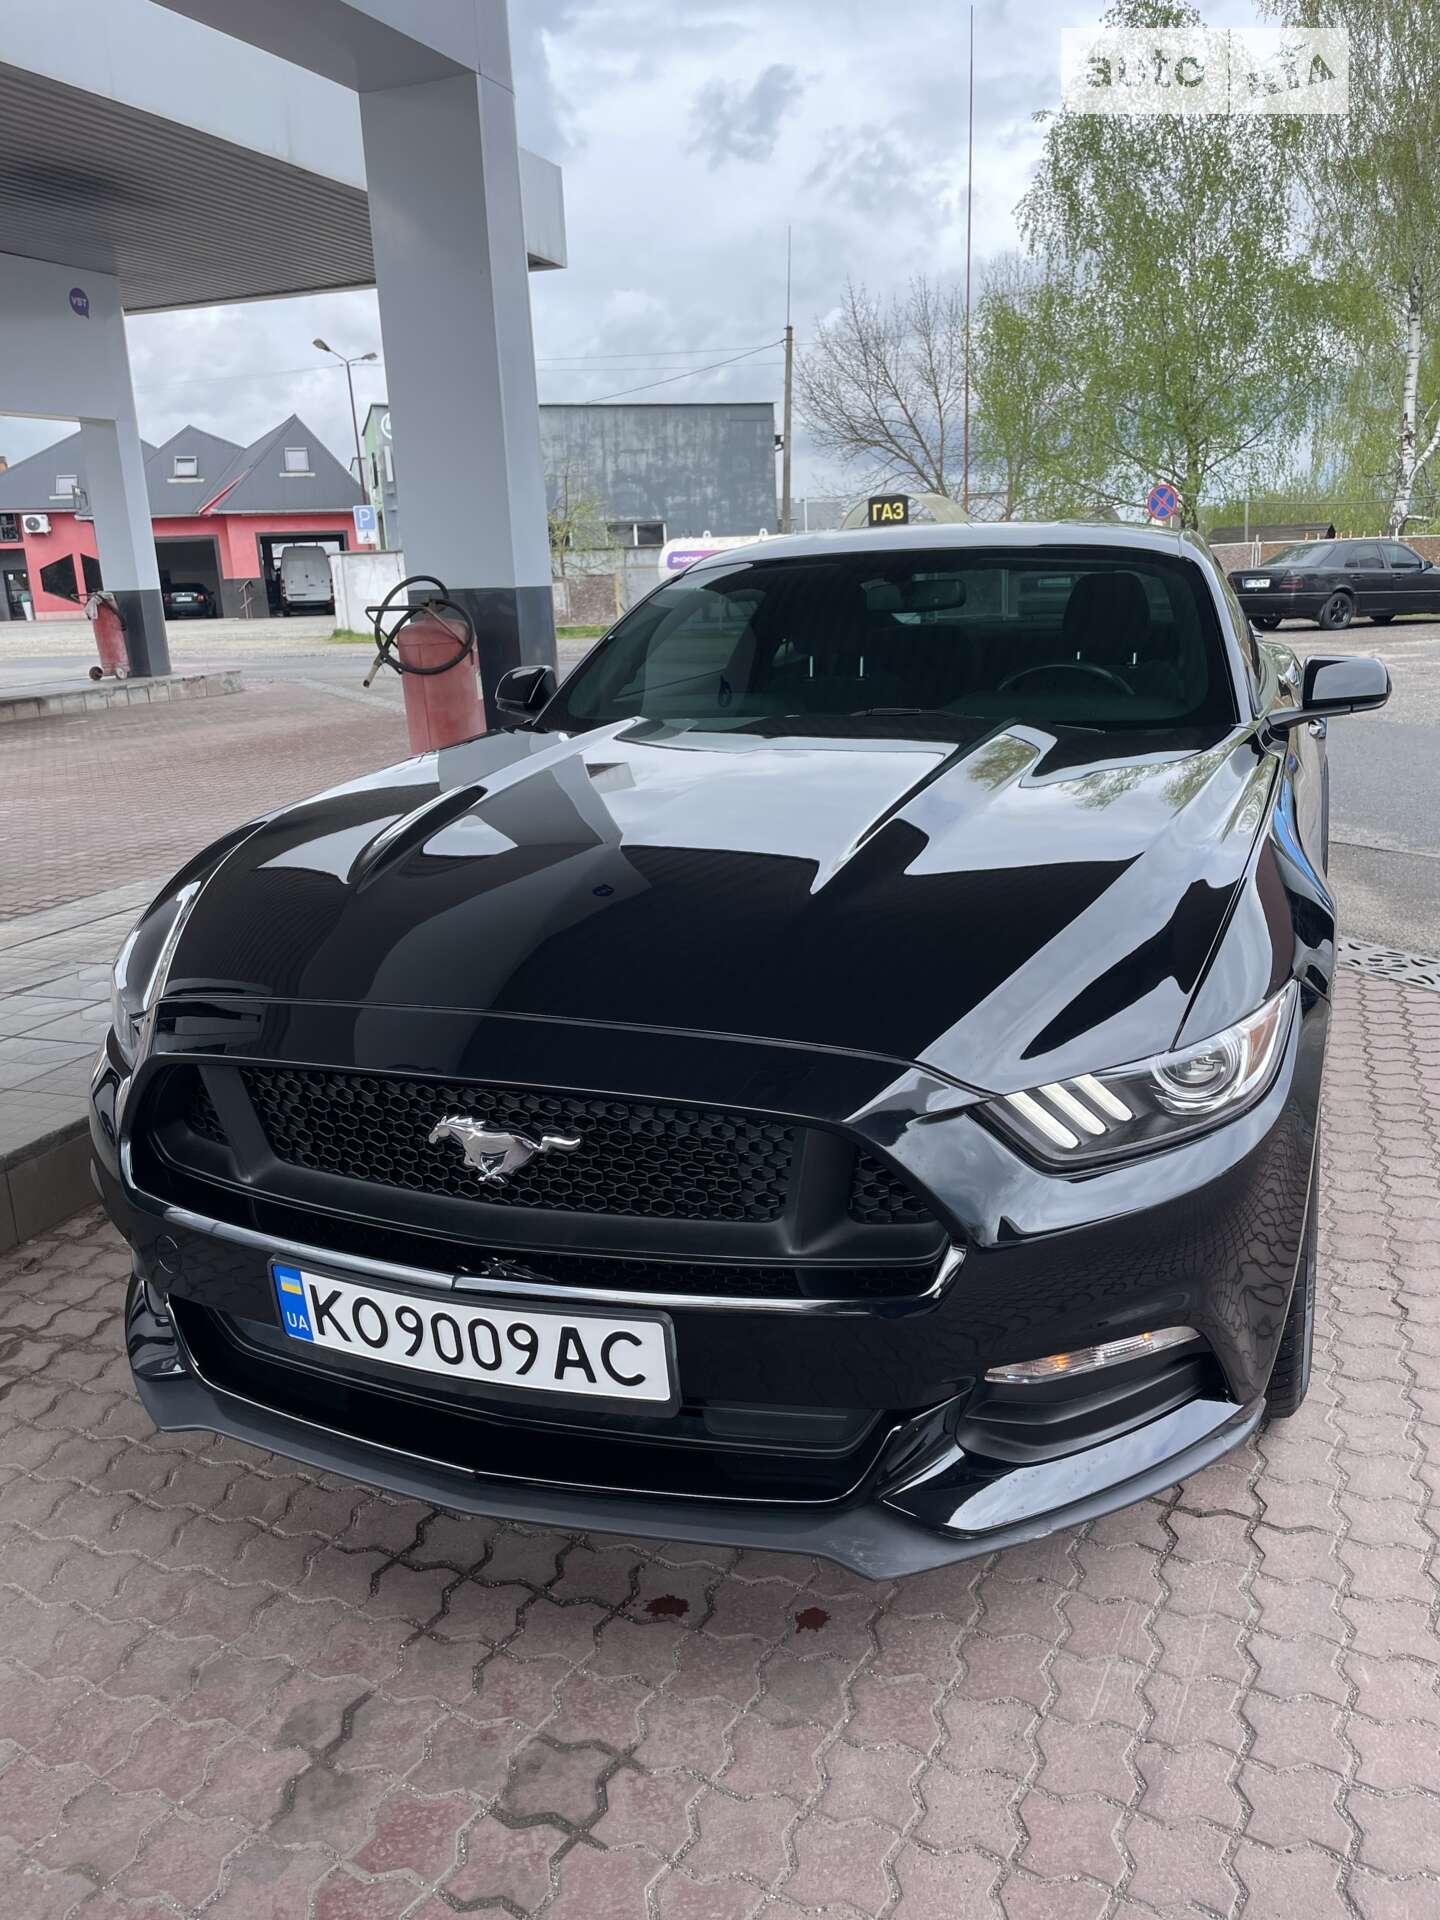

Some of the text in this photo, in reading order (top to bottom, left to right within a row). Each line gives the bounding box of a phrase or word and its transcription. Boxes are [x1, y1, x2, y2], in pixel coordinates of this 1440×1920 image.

[358, 508, 371, 528] P
[872, 502, 904, 521] ГАЗ
[286, 1311, 309, 1331] UA
[308, 1284, 647, 1387] KO9009AC
